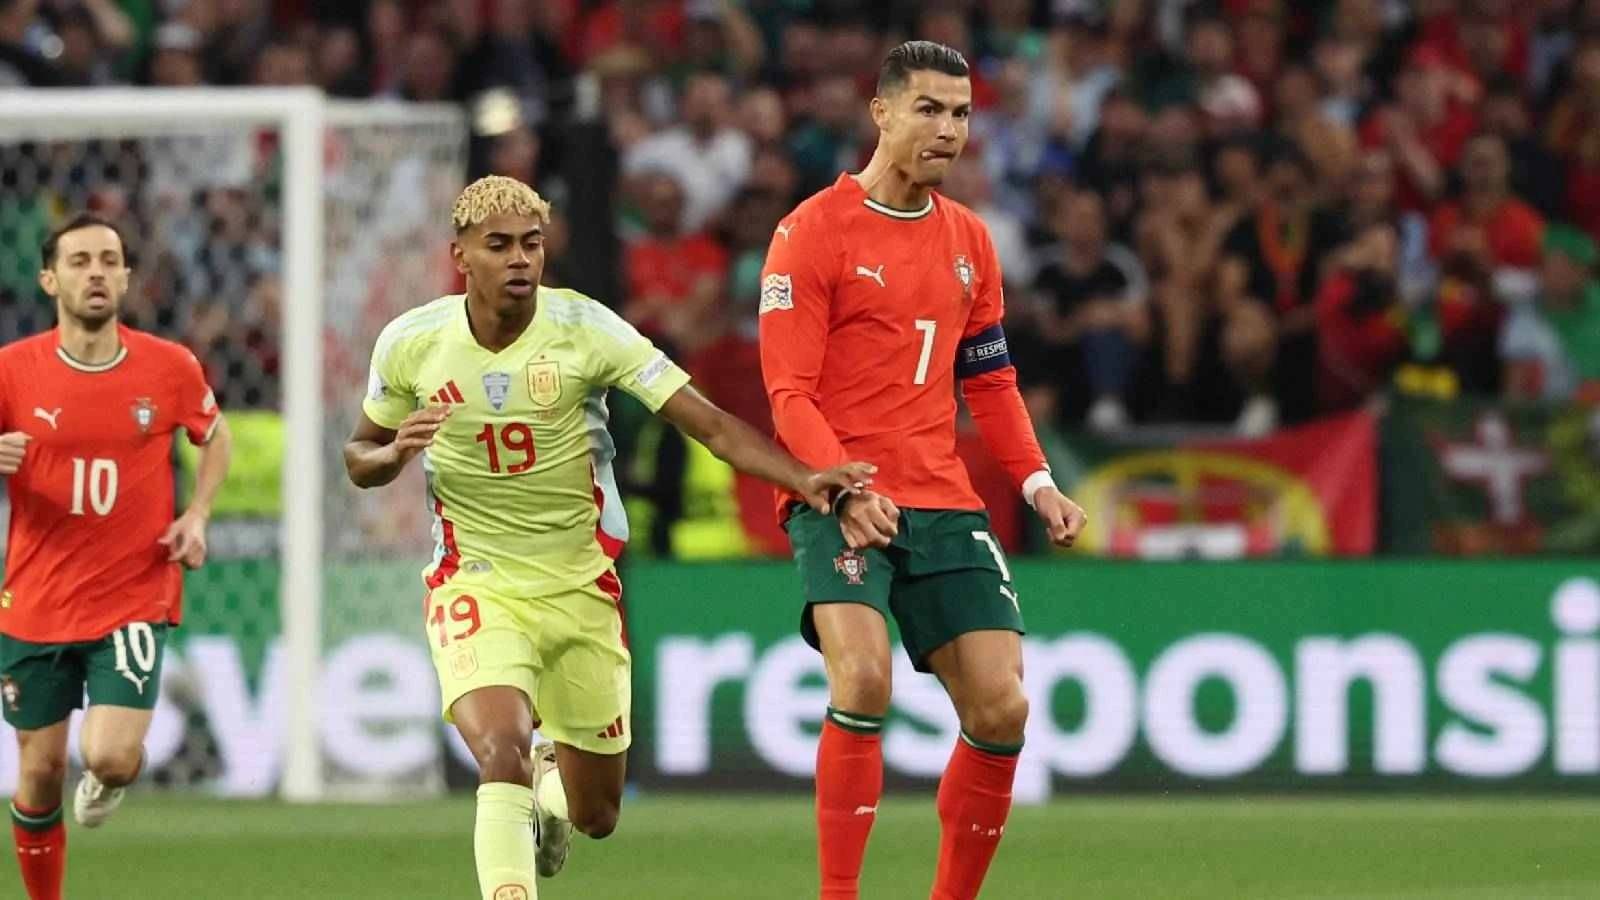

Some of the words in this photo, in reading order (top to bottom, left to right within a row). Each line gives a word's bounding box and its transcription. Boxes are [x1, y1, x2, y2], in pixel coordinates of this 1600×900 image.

[913, 319, 936, 385] 7
[476, 422, 537, 474] 19
[71, 457, 119, 516] 10
[113, 621, 156, 673] 10
[430, 594, 481, 648] 19
